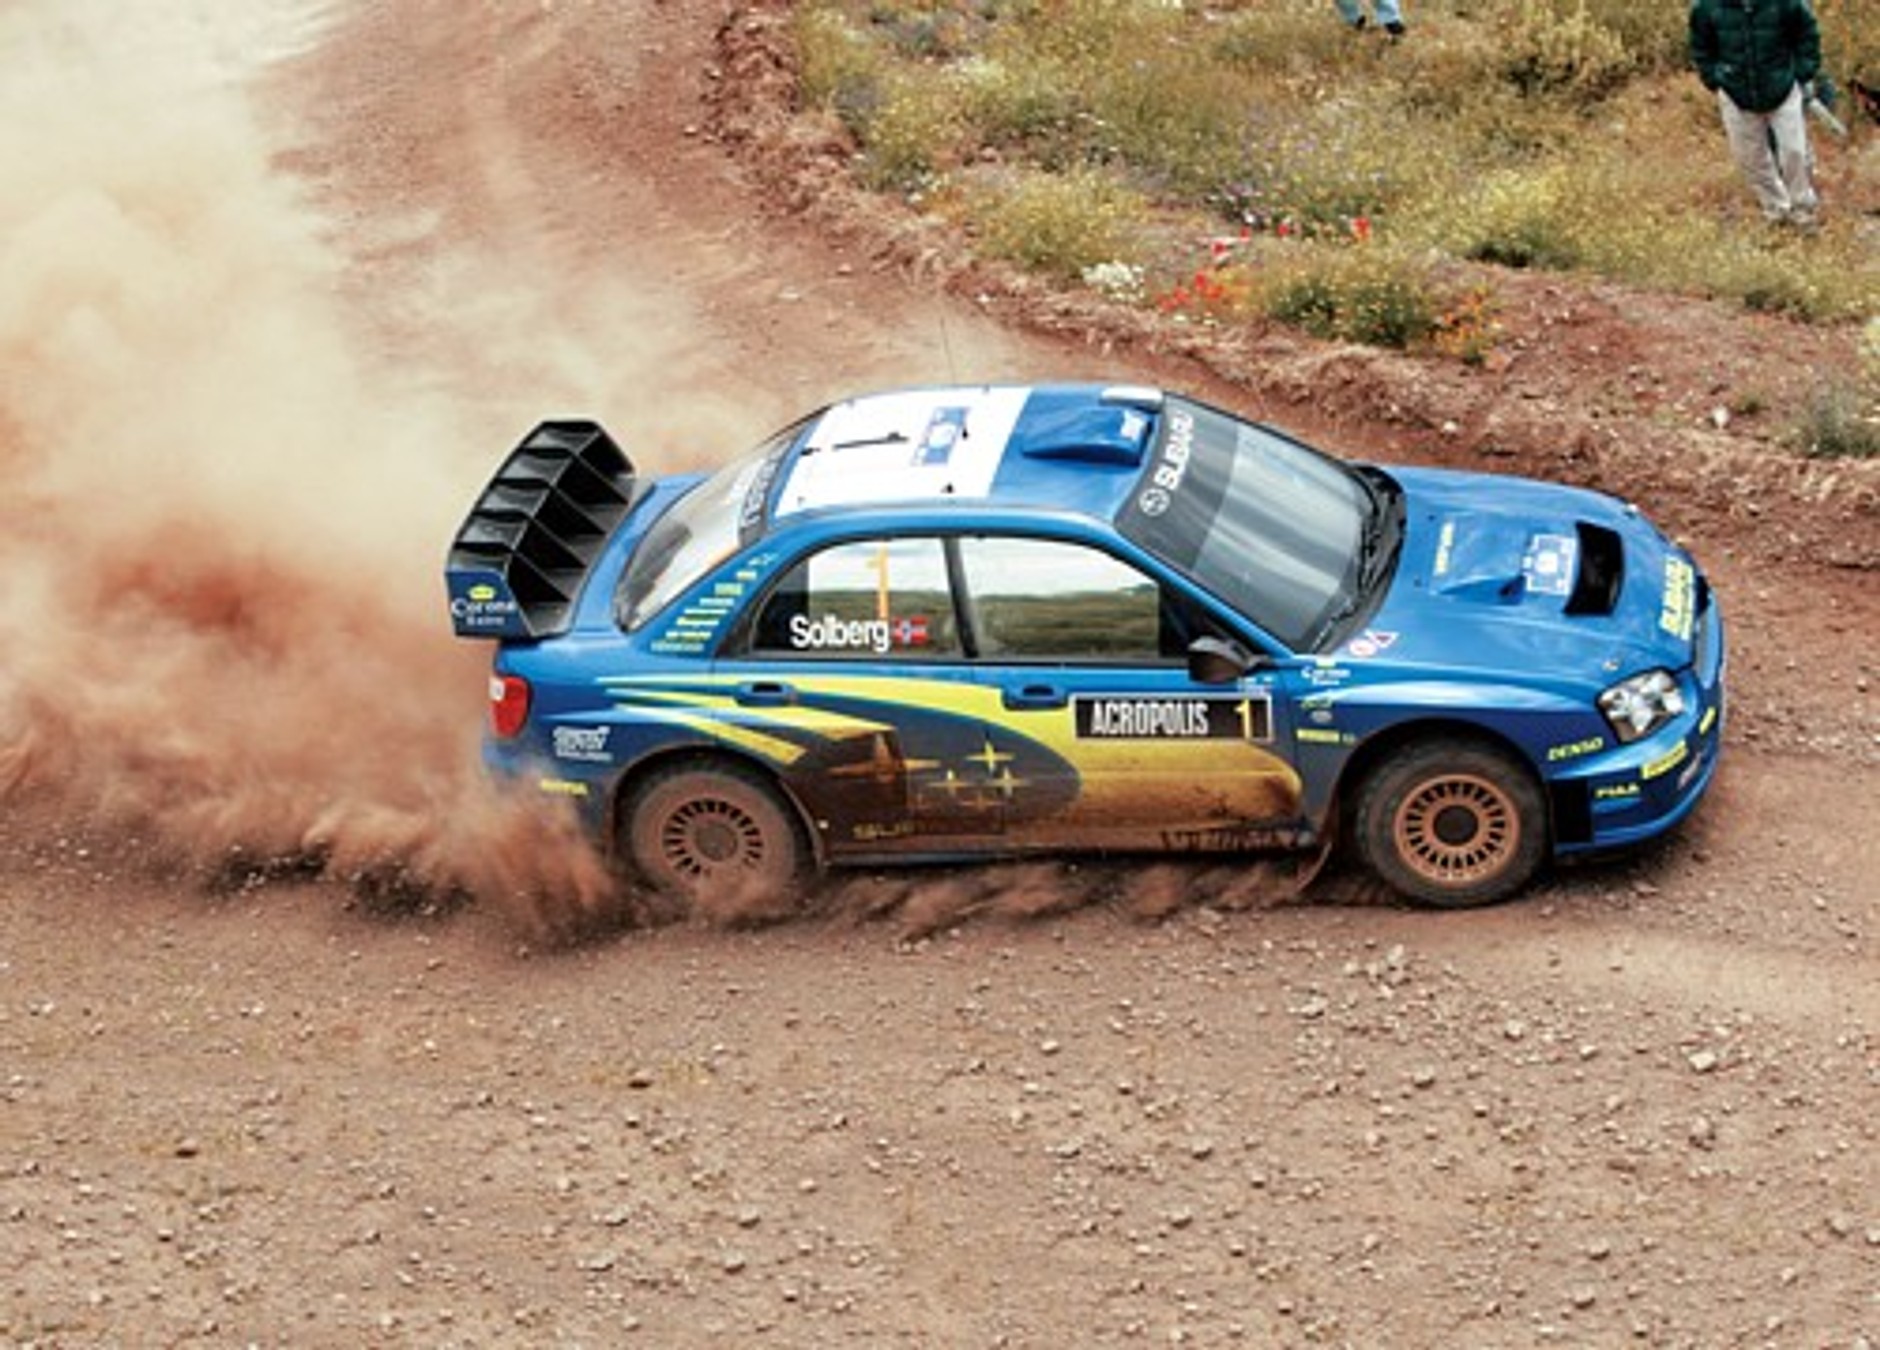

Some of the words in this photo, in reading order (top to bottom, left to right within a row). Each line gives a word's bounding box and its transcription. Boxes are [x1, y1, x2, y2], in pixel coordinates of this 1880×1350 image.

[789, 614, 889, 653] Solberg
[1091, 700, 1209, 735] ACROPOLIS
[1234, 700, 1252, 739] 1
[1548, 737, 1604, 760] DENSO
